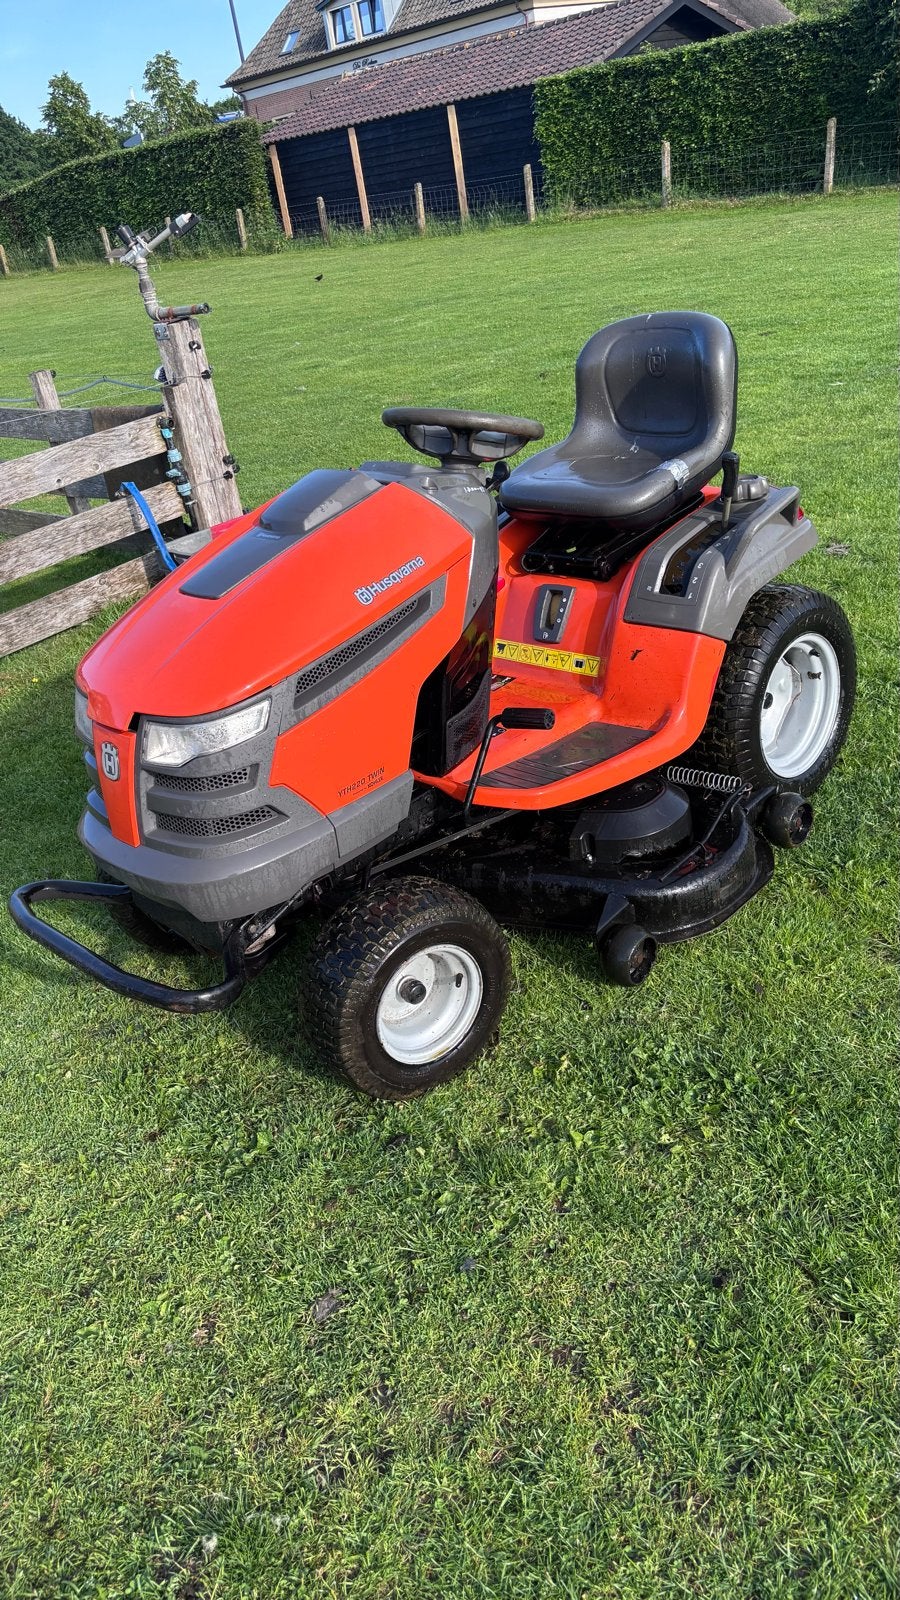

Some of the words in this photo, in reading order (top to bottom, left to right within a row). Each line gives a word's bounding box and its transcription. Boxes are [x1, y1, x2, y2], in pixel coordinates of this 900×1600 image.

[367, 556, 426, 596] Husqvarna
[692, 576, 698, 584] 2
[337, 777, 366, 797] YTH220
[367, 765, 385, 782] TWIN
